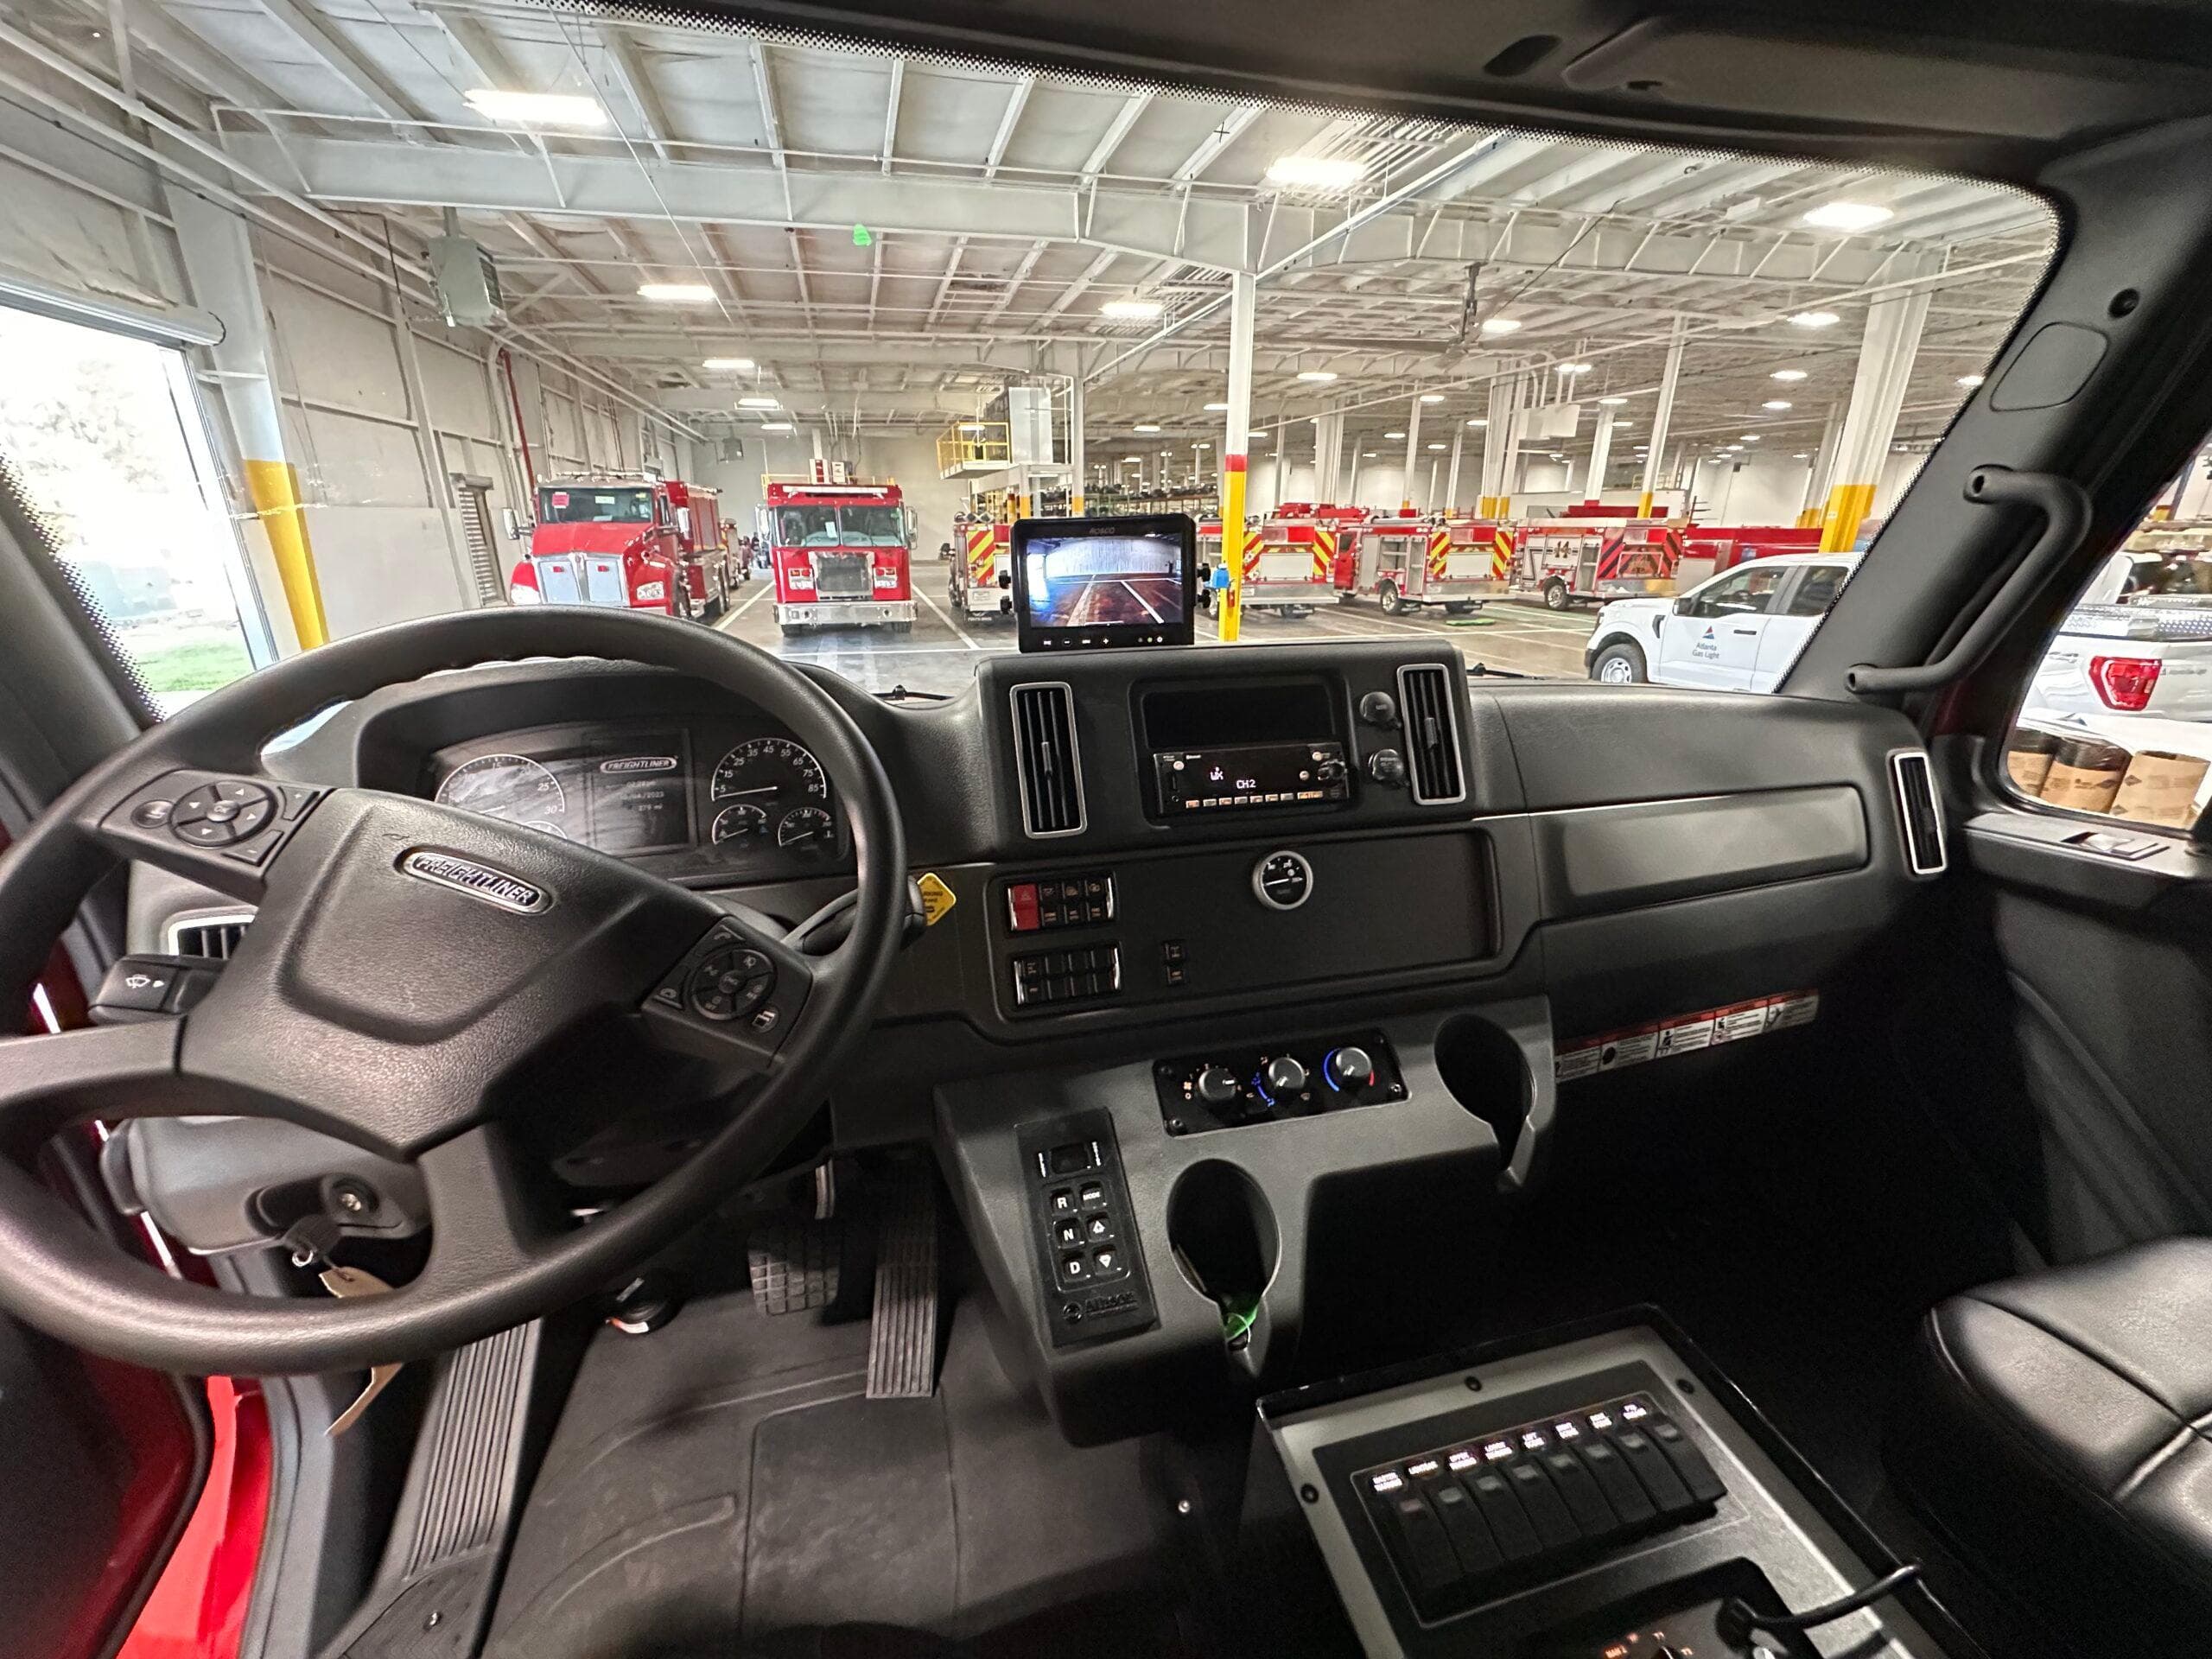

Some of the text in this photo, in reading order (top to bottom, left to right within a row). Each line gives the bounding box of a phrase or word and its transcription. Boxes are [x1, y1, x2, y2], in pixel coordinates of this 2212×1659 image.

[1696, 642, 1717, 651] Atlanta
[747, 748, 759, 757] 35
[780, 748, 791, 757] 55
[607, 760, 671, 771] FREIGHTLINER
[734, 758, 745, 766] 25
[537, 783, 550, 791] 25
[544, 805, 557, 815] 30
[416, 857, 533, 904] FREIGHTLINER
[1083, 1192, 1100, 1201] MODE
[1058, 1197, 1067, 1209] R
[1063, 1228, 1074, 1241] N
[1070, 1262, 1081, 1274] D
